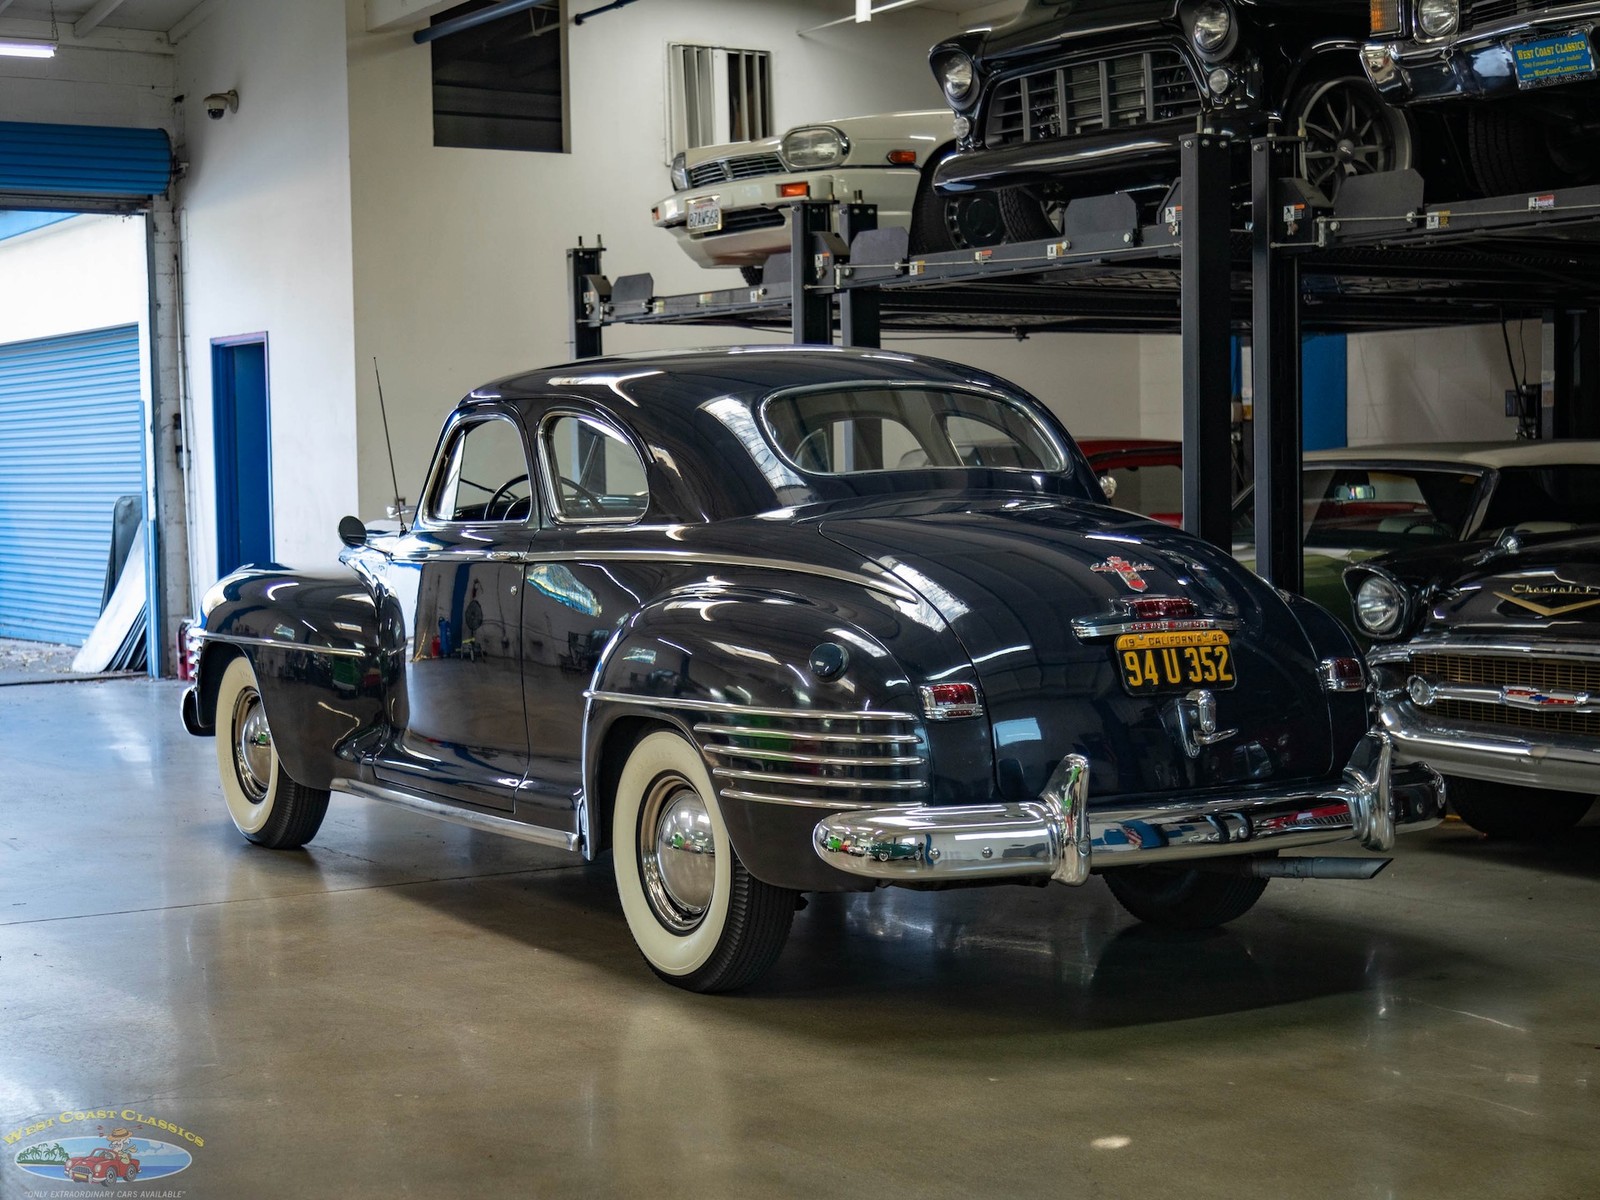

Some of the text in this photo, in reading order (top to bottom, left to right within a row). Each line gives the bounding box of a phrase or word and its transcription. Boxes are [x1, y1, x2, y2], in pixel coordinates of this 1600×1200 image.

[1517, 41, 1586, 60] WEST COAST CLASSICS
[1511, 584, 1598, 595] Chevrolet
[1125, 634, 1223, 647] 19 CALIFORNIA 42
[1123, 646, 1233, 687] 94 U 352
